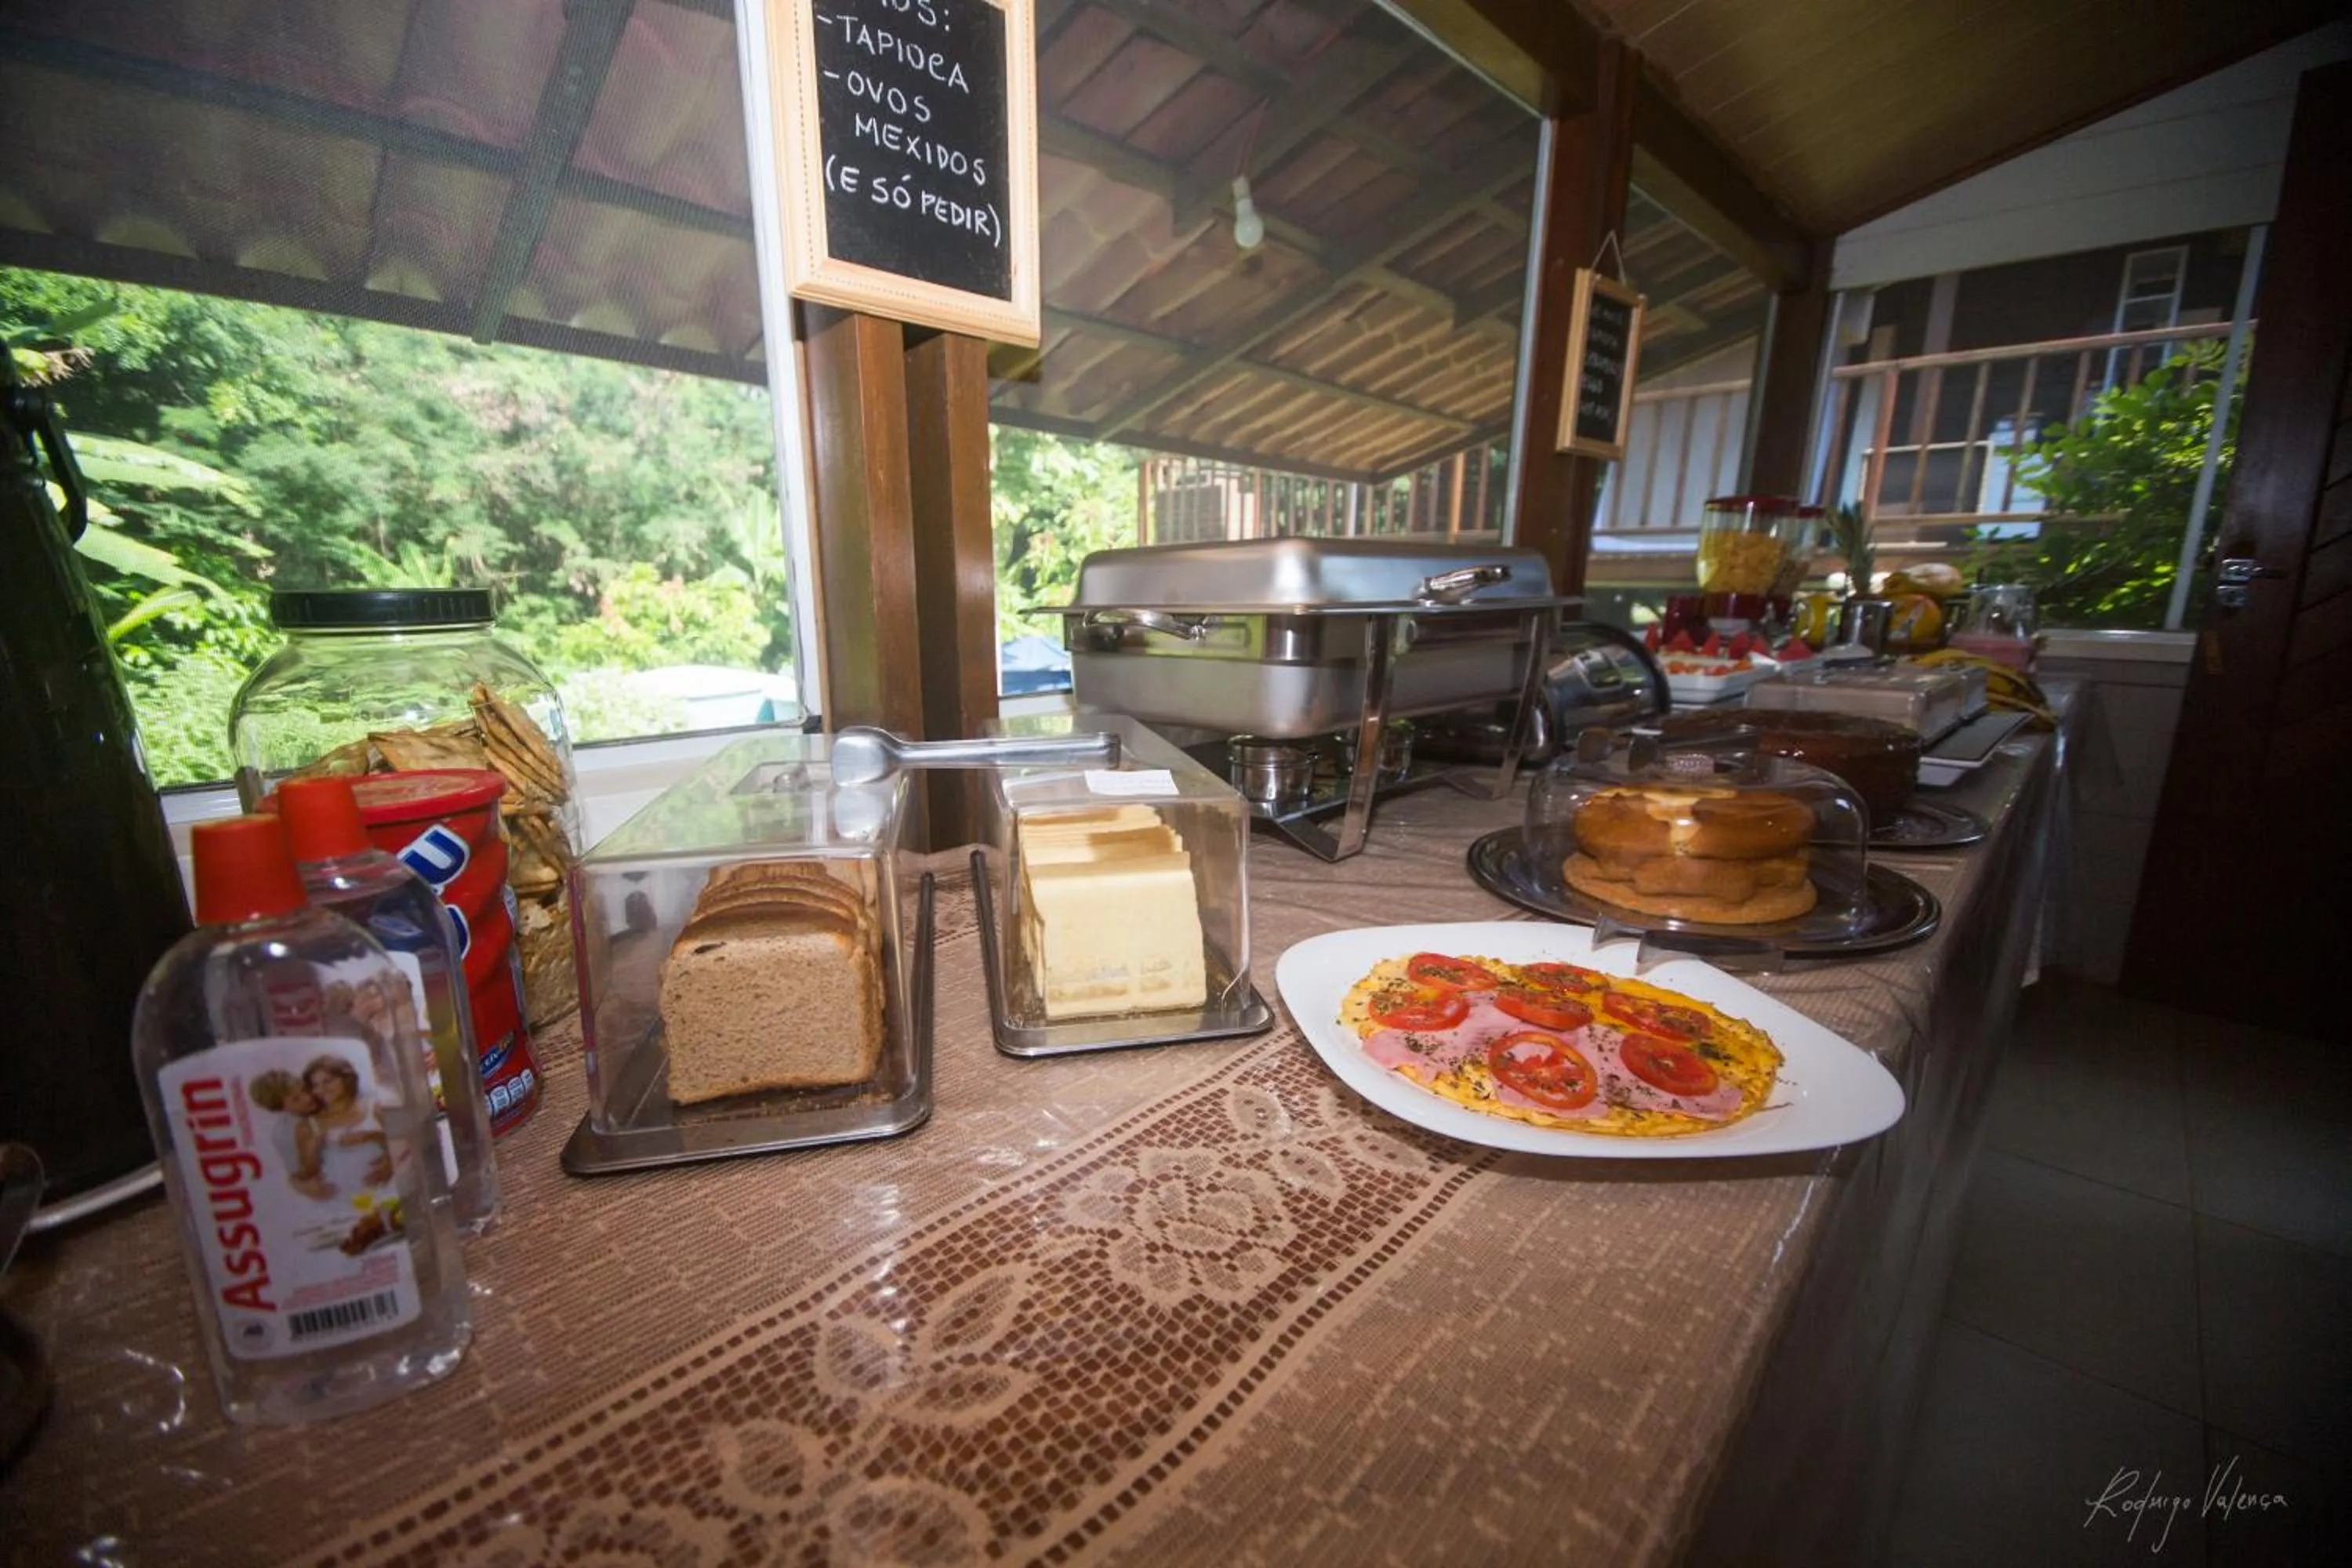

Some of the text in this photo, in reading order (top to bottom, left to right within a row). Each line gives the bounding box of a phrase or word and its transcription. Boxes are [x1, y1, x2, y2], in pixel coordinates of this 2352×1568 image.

[855, 113, 985, 187] MEXIDOS
[872, 174, 911, 209] SÓ
[921, 191, 1001, 248] PEDIR)
[182, 1077, 276, 1312] Assugrin
